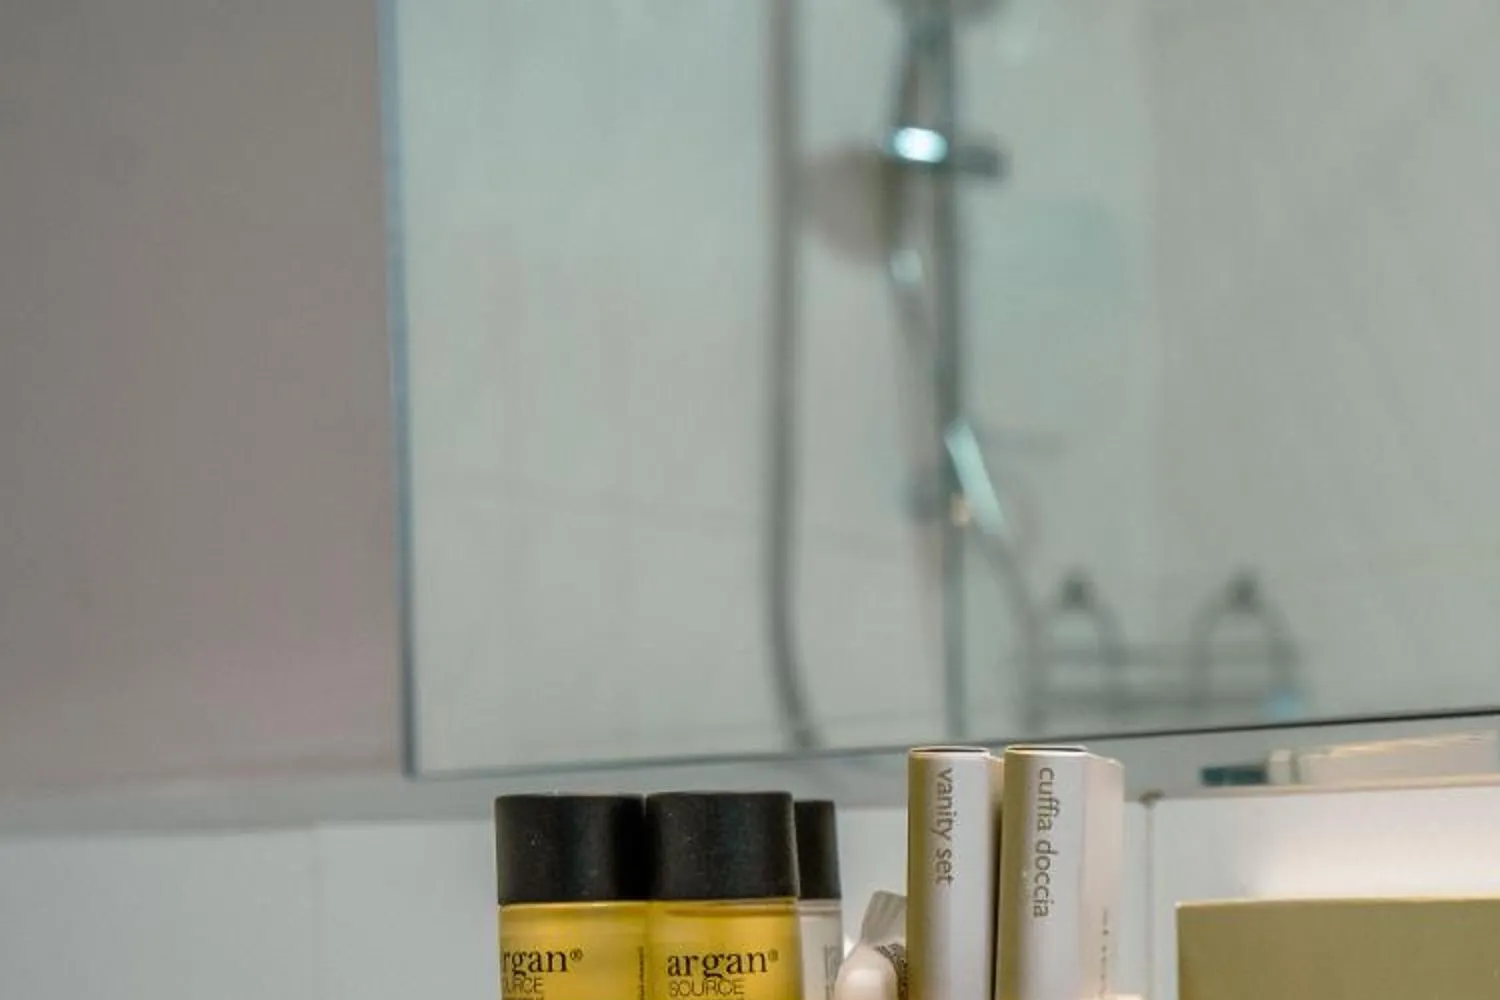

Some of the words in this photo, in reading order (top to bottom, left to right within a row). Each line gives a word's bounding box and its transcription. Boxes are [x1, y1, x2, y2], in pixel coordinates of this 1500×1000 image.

[931, 767, 957, 841] vanity
[1037, 767, 1060, 831] cuffia
[935, 848, 955, 886] set
[1033, 839, 1059, 918] doccia
[669, 978, 745, 997] SOURCE
